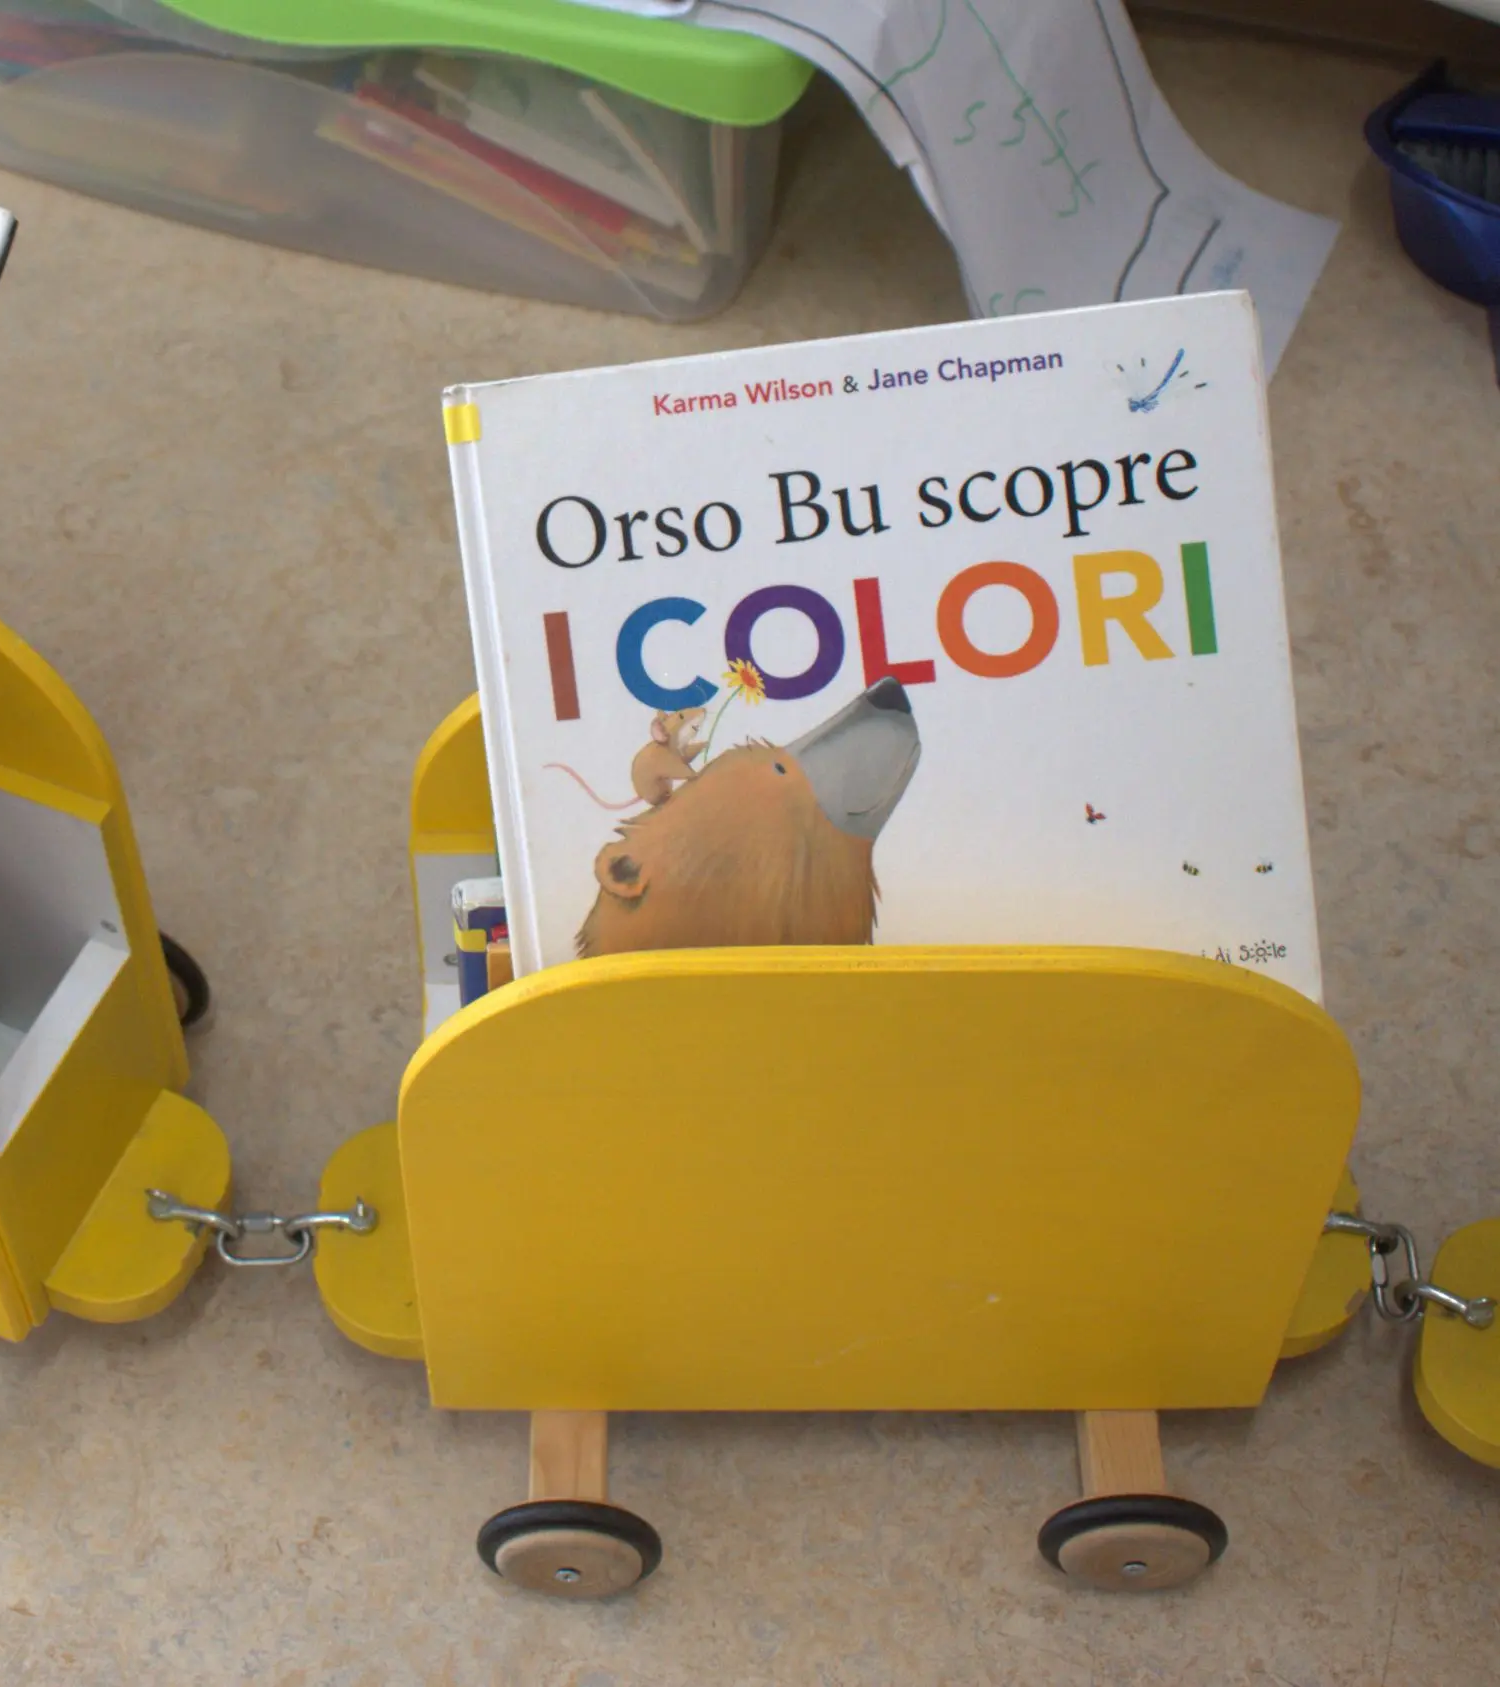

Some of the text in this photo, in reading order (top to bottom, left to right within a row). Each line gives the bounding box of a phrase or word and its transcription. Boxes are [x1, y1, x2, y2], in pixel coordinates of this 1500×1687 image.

[653, 350, 1065, 416] Karma Wilson & Jane Chapman
[535, 448, 1199, 570] Orso Bu scopre
[543, 541, 1219, 721] I COLORI
[1239, 939, 1288, 964] Sole
